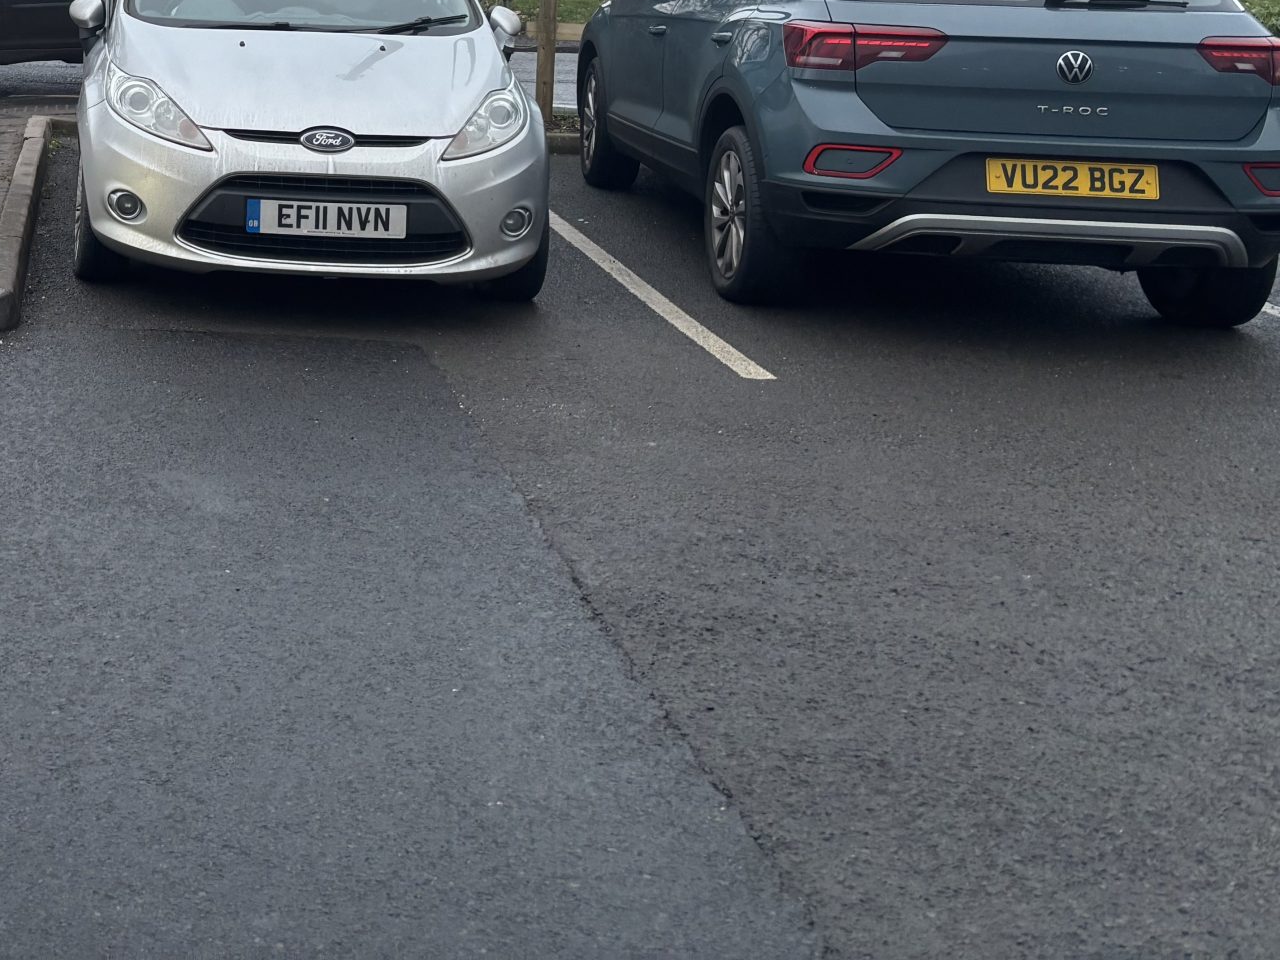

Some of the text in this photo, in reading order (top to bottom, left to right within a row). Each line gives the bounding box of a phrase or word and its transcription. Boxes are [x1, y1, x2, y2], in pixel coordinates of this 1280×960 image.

[1037, 105, 1109, 116] T-ROC
[312, 132, 342, 146] Ford
[1000, 162, 1146, 195] VU22 BGZ
[277, 203, 391, 232] EF11 NVN
